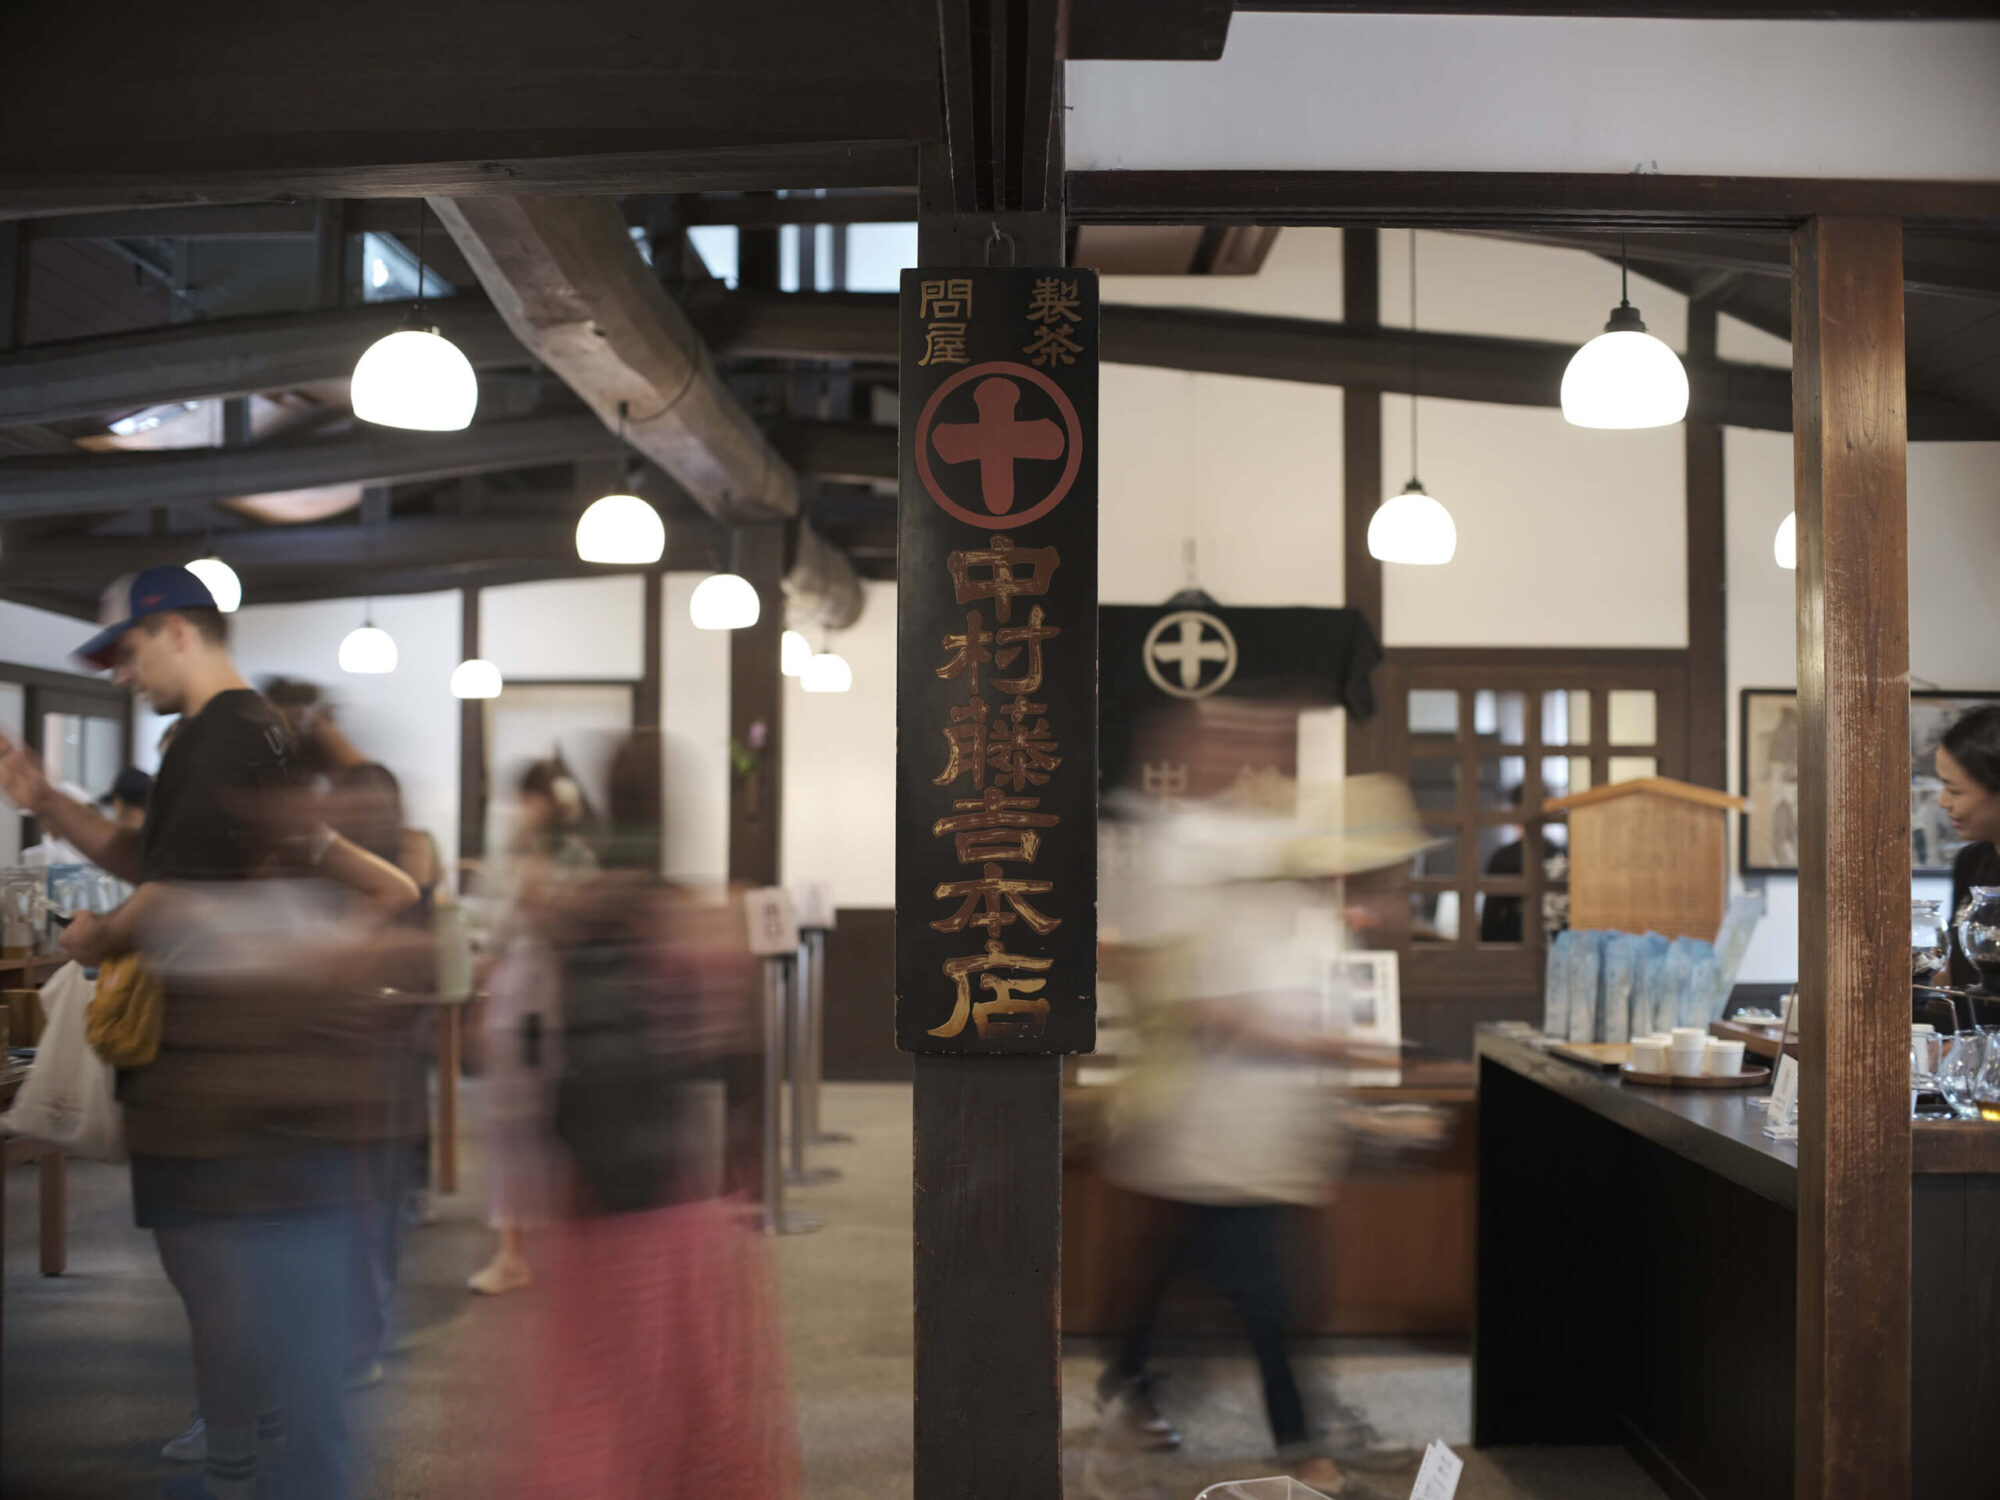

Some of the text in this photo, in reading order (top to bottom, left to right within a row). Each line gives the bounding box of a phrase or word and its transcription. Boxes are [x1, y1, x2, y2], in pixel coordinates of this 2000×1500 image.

[918, 278, 973, 367] 問屋
[1022, 276, 1084, 368] 製茶
[926, 533, 1063, 1038] 中村藤吉本店
